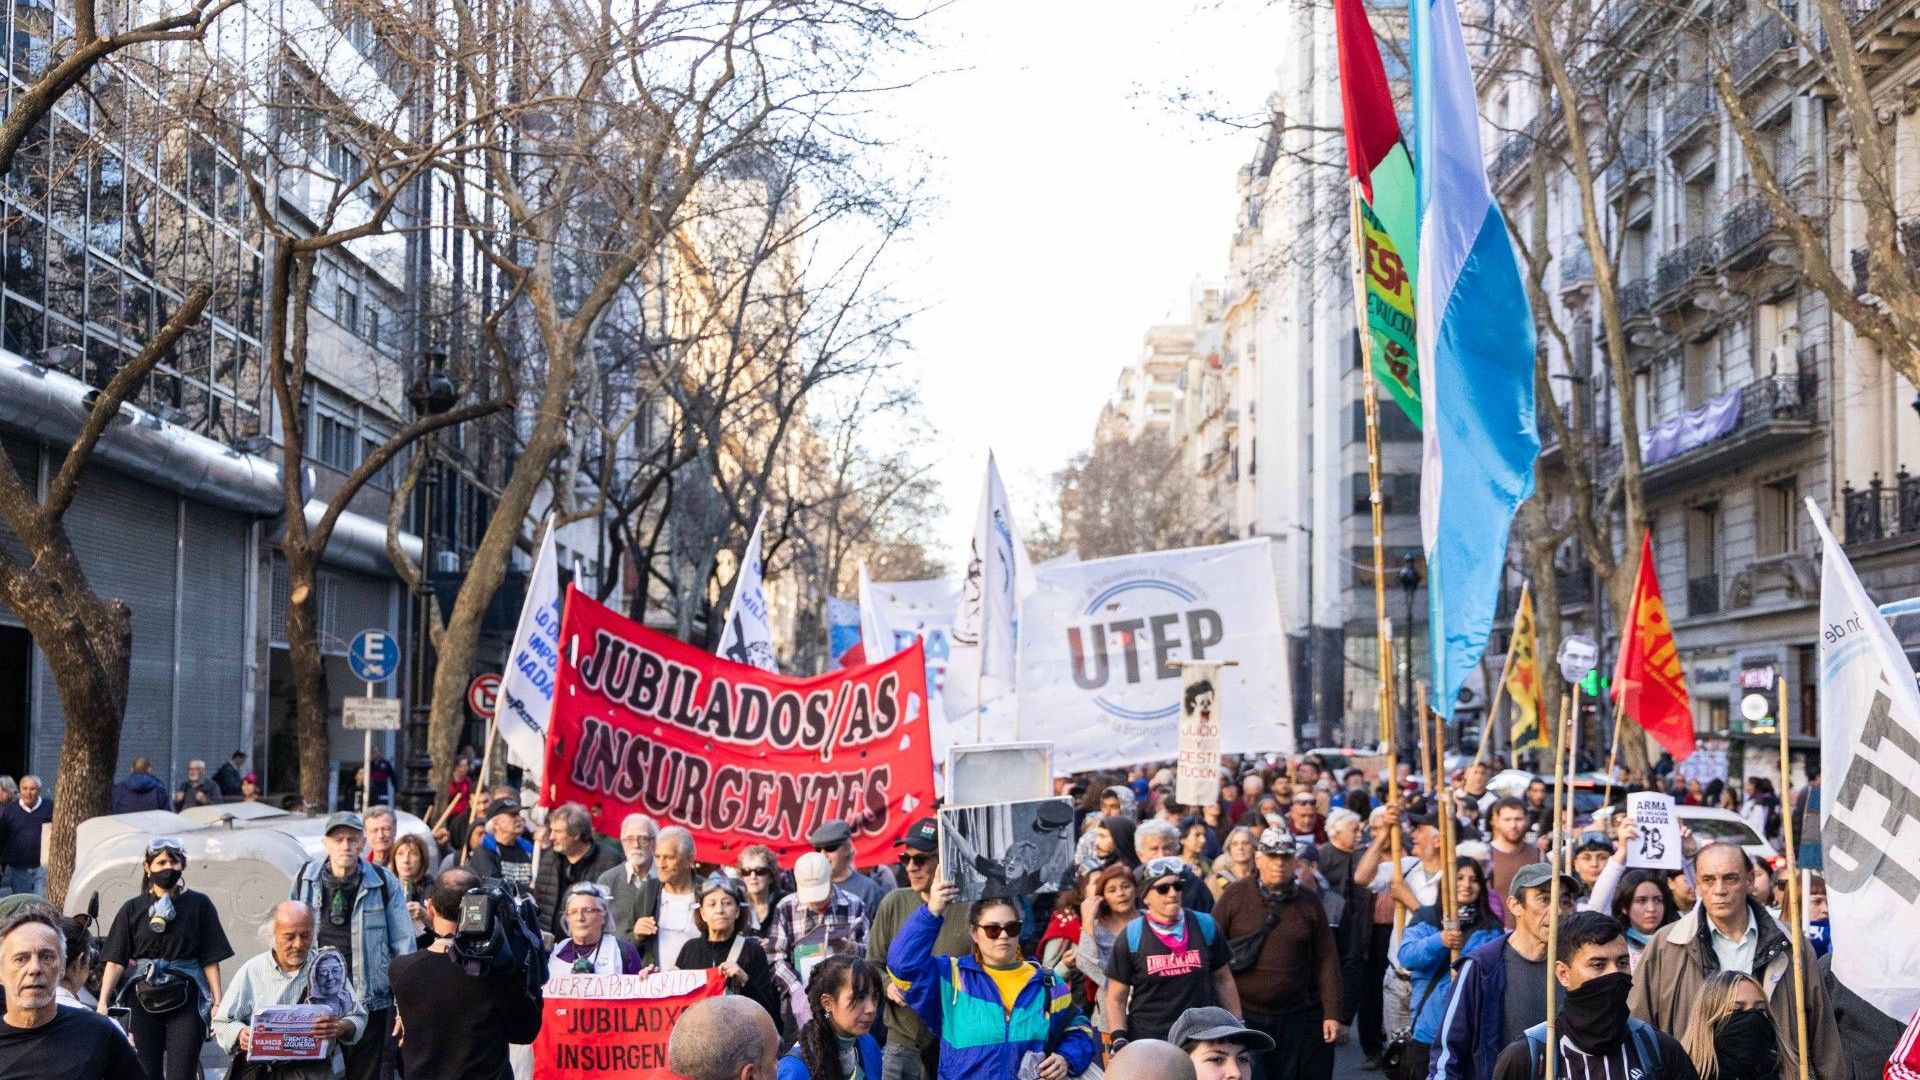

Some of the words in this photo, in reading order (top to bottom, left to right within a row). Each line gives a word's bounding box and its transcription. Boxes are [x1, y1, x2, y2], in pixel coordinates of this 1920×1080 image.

[364, 633, 385, 661] E
[528, 632, 557, 672] IMPO
[1067, 609, 1223, 690] UTEP
[516, 650, 554, 700] NADA
[580, 630, 899, 760] JUBILADOS/AS
[1181, 724, 1217, 737] JUICIO
[1194, 740, 1202, 749] Y
[572, 717, 890, 842] INSURGENTES
[1637, 800, 1667, 811] ARMA
[1637, 816, 1669, 824] MASIVA
[548, 977, 602, 997] UERZA
[566, 1005, 690, 1034] JUBILADX
[556, 1042, 666, 1072] INSURGEN
